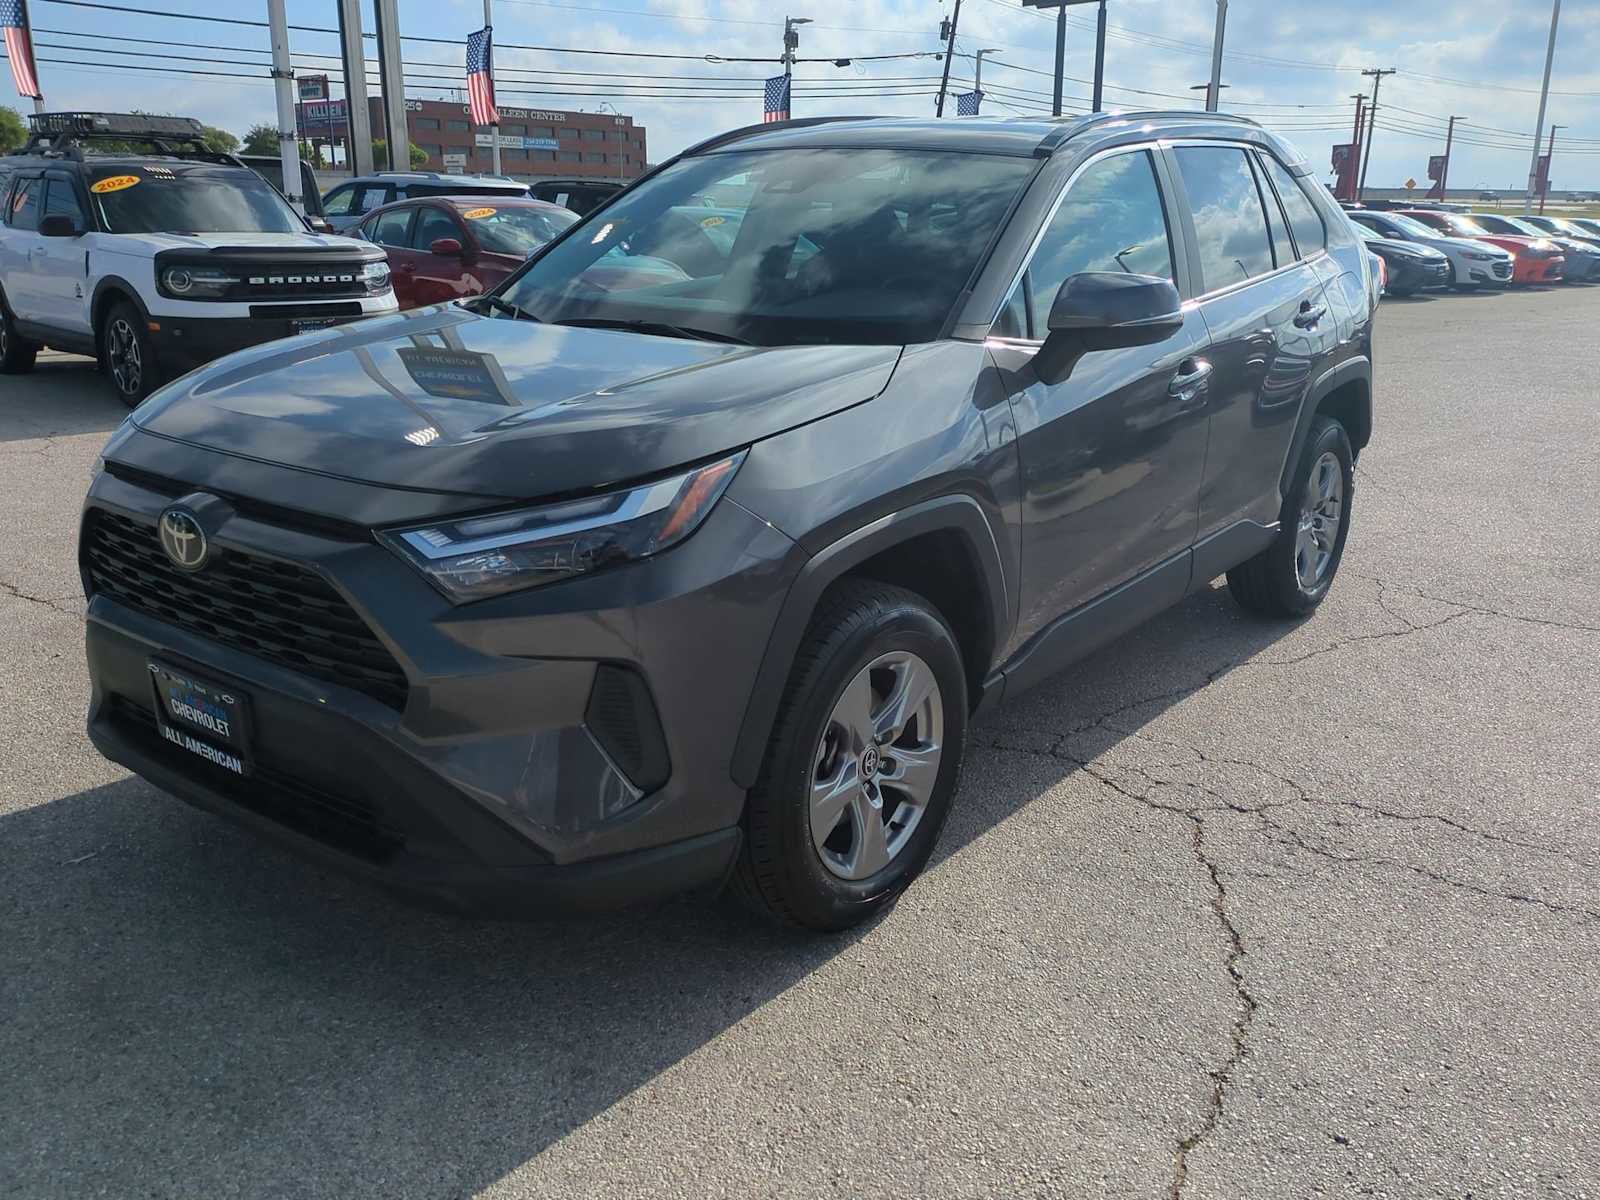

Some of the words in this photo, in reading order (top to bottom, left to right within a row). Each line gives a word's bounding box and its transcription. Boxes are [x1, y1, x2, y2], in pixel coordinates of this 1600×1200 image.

[531, 110, 567, 121] CENTER
[97, 176, 135, 192] 2024
[248, 275, 353, 285] BRONCO
[171, 698, 230, 737] CHEVROLET
[165, 726, 185, 748] ALL
[185, 737, 242, 774] AMERICAN
